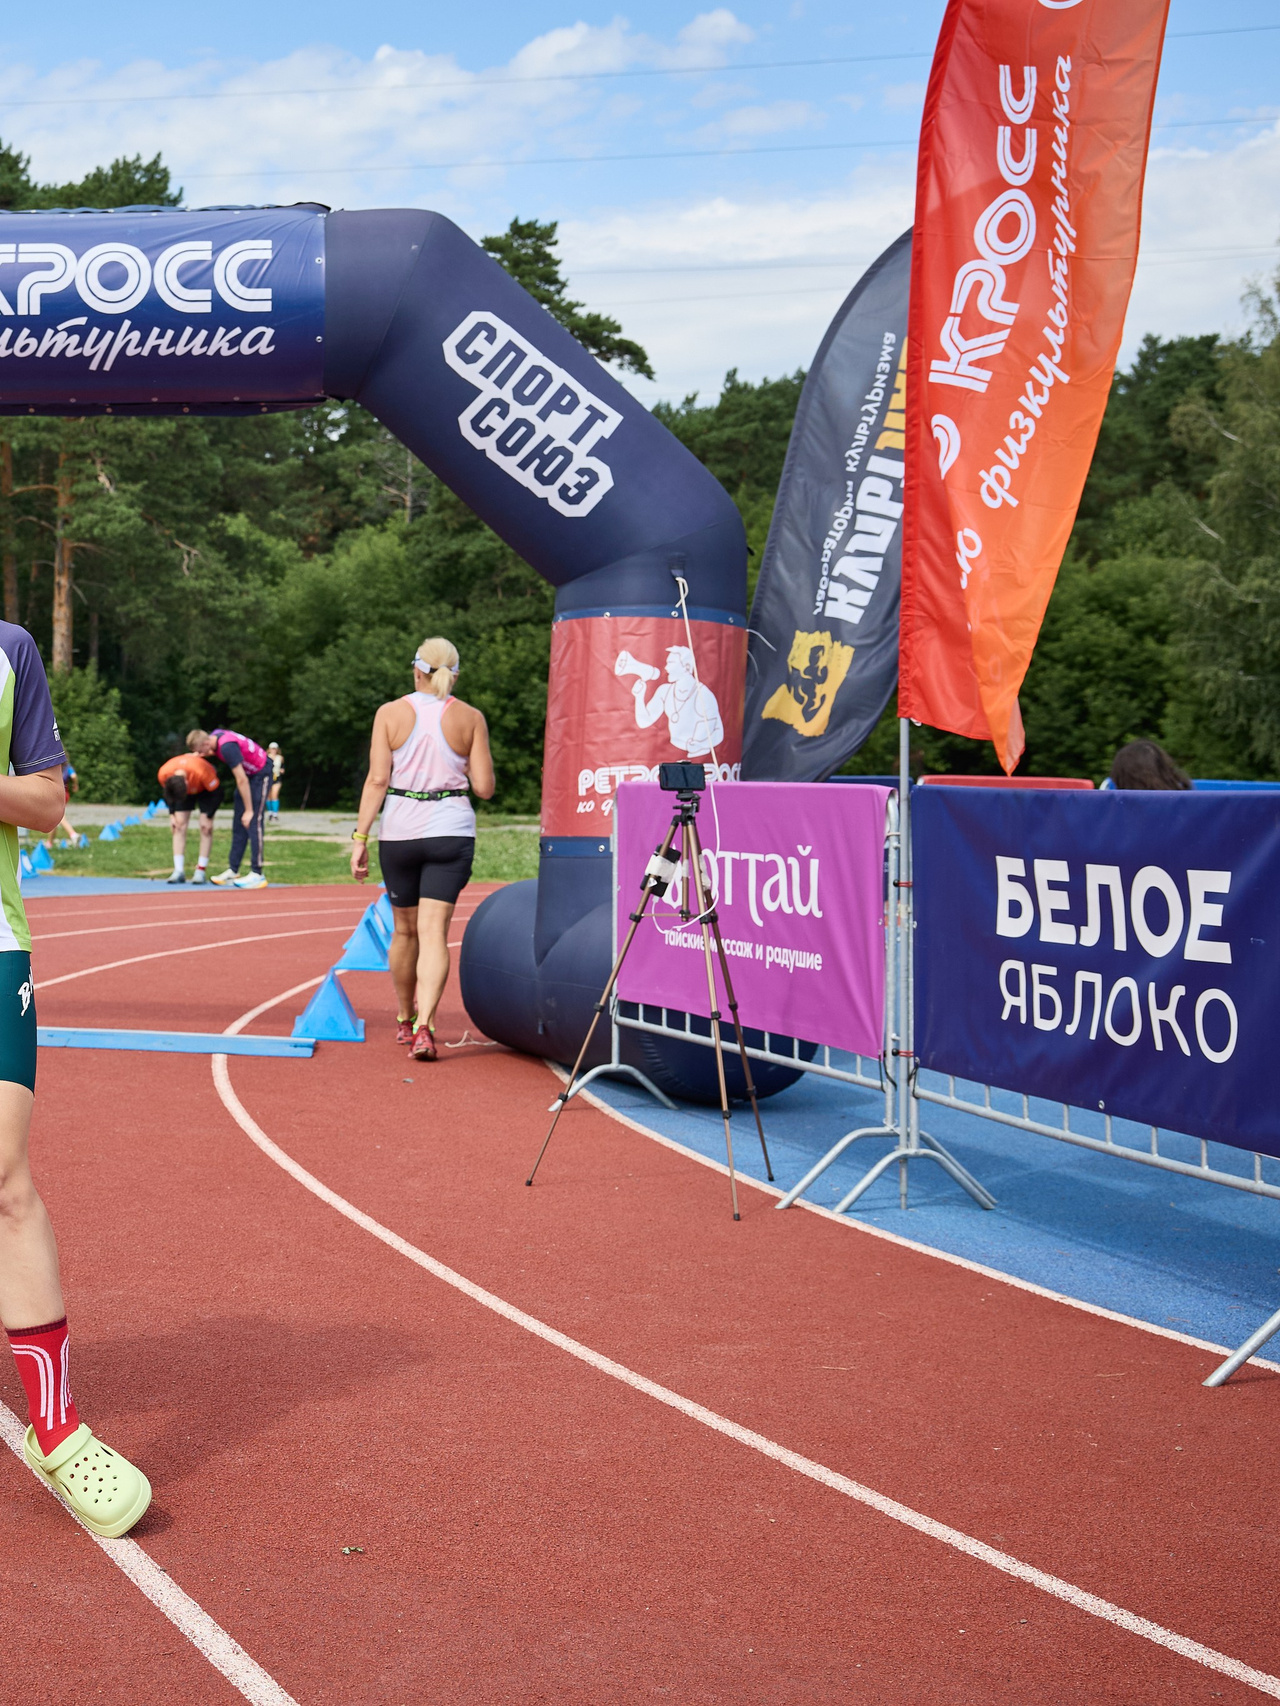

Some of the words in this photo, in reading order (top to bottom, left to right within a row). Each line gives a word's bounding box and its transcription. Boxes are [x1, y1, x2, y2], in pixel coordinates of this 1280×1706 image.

[928, 64, 1037, 393] КРОСС
[980, 55, 1077, 509] физкультурника
[455, 321, 609, 446] СПОРТ
[470, 397, 600, 505] СОЮЗ
[577, 800, 595, 813] ко
[709, 938, 754, 959] мссаж
[755, 943, 763, 961] и
[765, 945, 823, 974] радушие
[994, 855, 1232, 964] БЕЛОЕ
[999, 958, 1238, 1065] ЯБЛОКО
